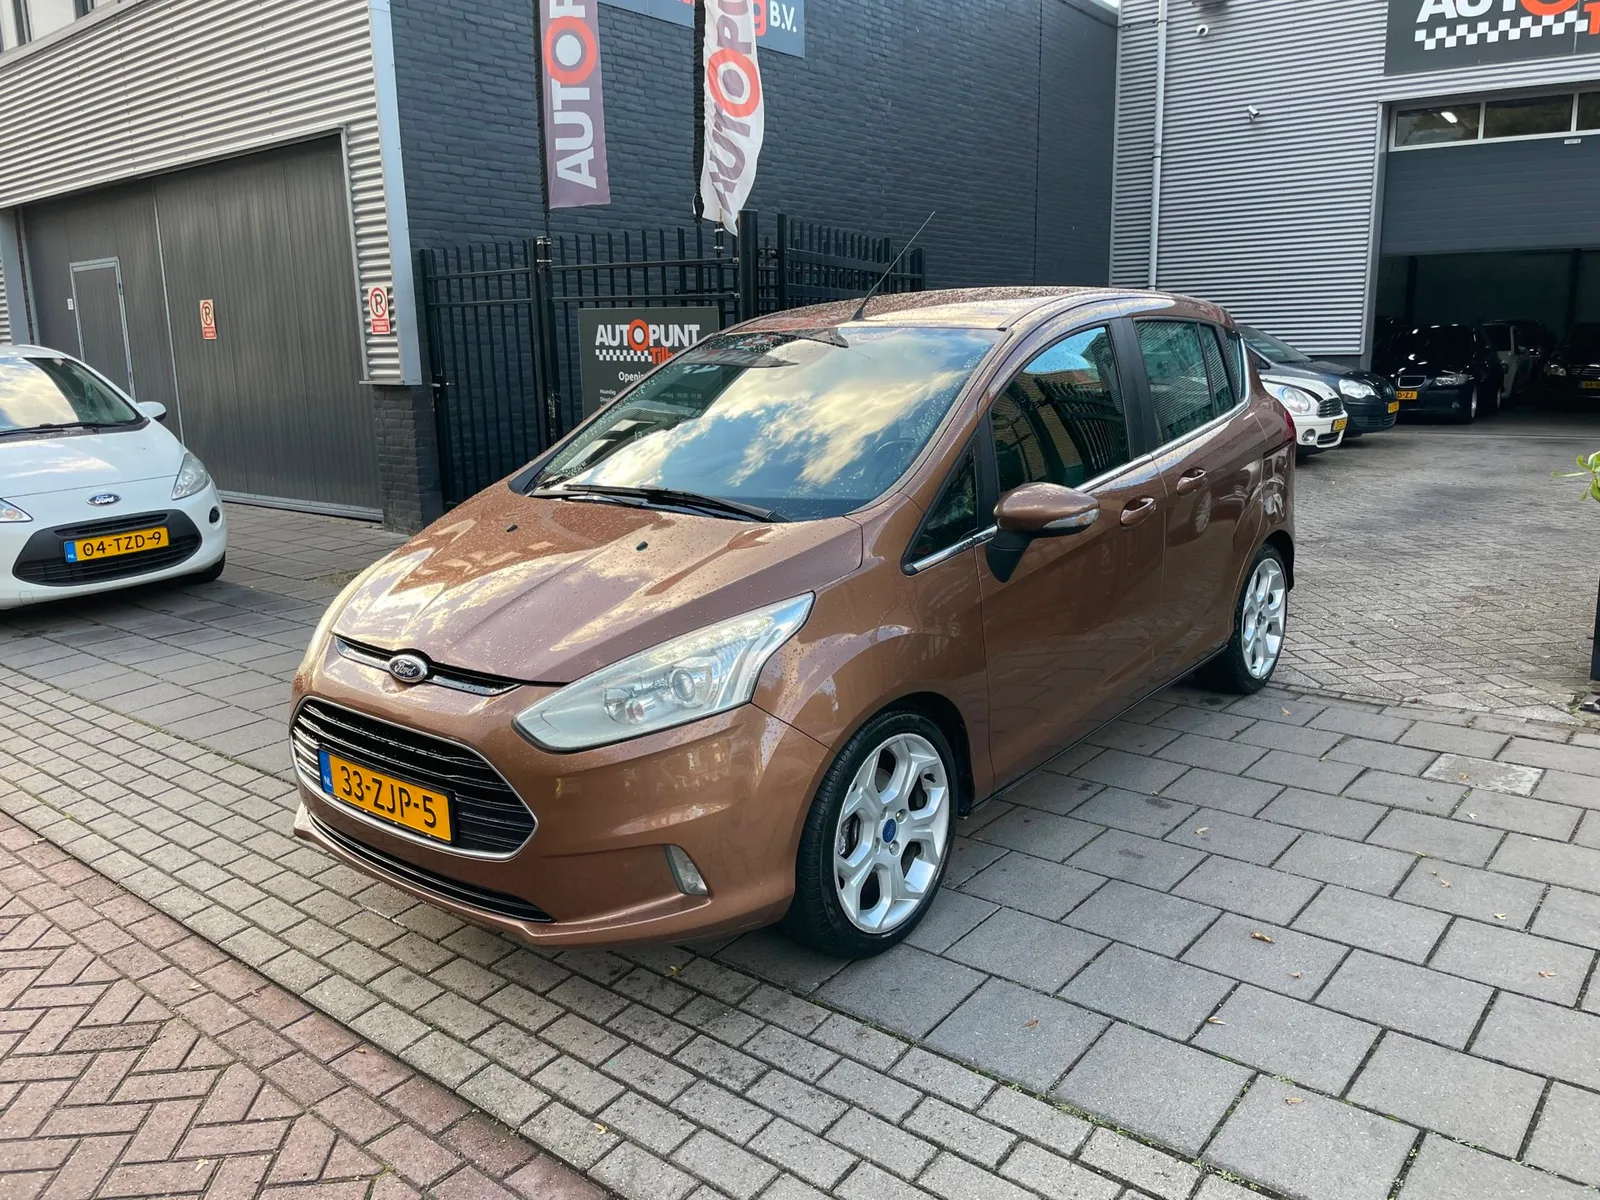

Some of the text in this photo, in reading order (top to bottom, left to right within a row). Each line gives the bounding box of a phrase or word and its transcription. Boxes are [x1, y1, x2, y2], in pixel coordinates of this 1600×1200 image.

[769, 1, 797, 33] B.V.
[595, 319, 700, 351] AUTOPUNT
[83, 532, 162, 556] 04-TZD-9
[394, 659, 415, 677] Ford
[340, 765, 437, 829] 33-ZJP-5
